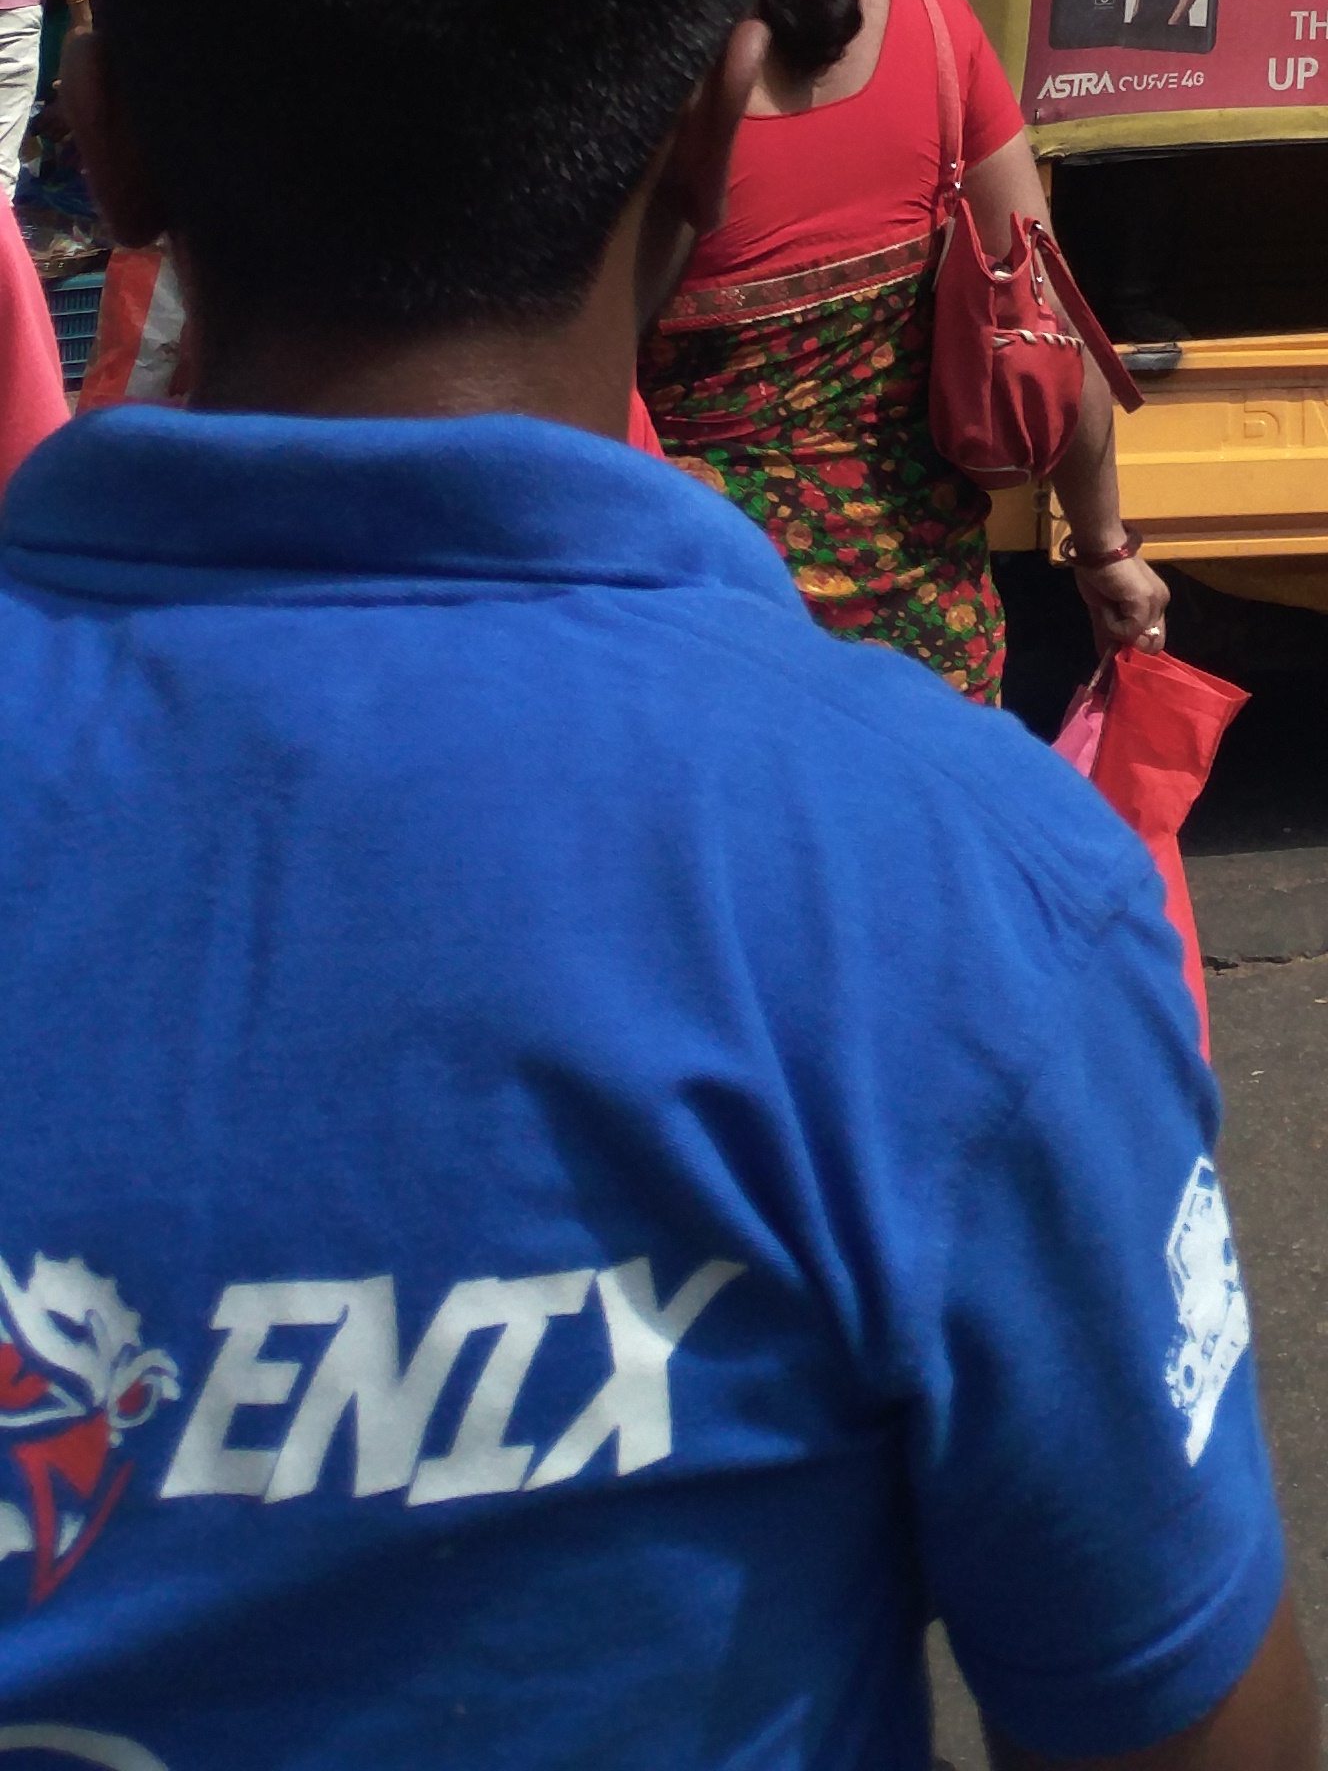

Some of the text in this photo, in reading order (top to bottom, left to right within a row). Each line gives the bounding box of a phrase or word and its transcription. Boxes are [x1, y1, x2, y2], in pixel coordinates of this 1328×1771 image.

[1037, 69, 1205, 100] ASTRA CURVE 4G
[1268, 57, 1319, 91] UP
